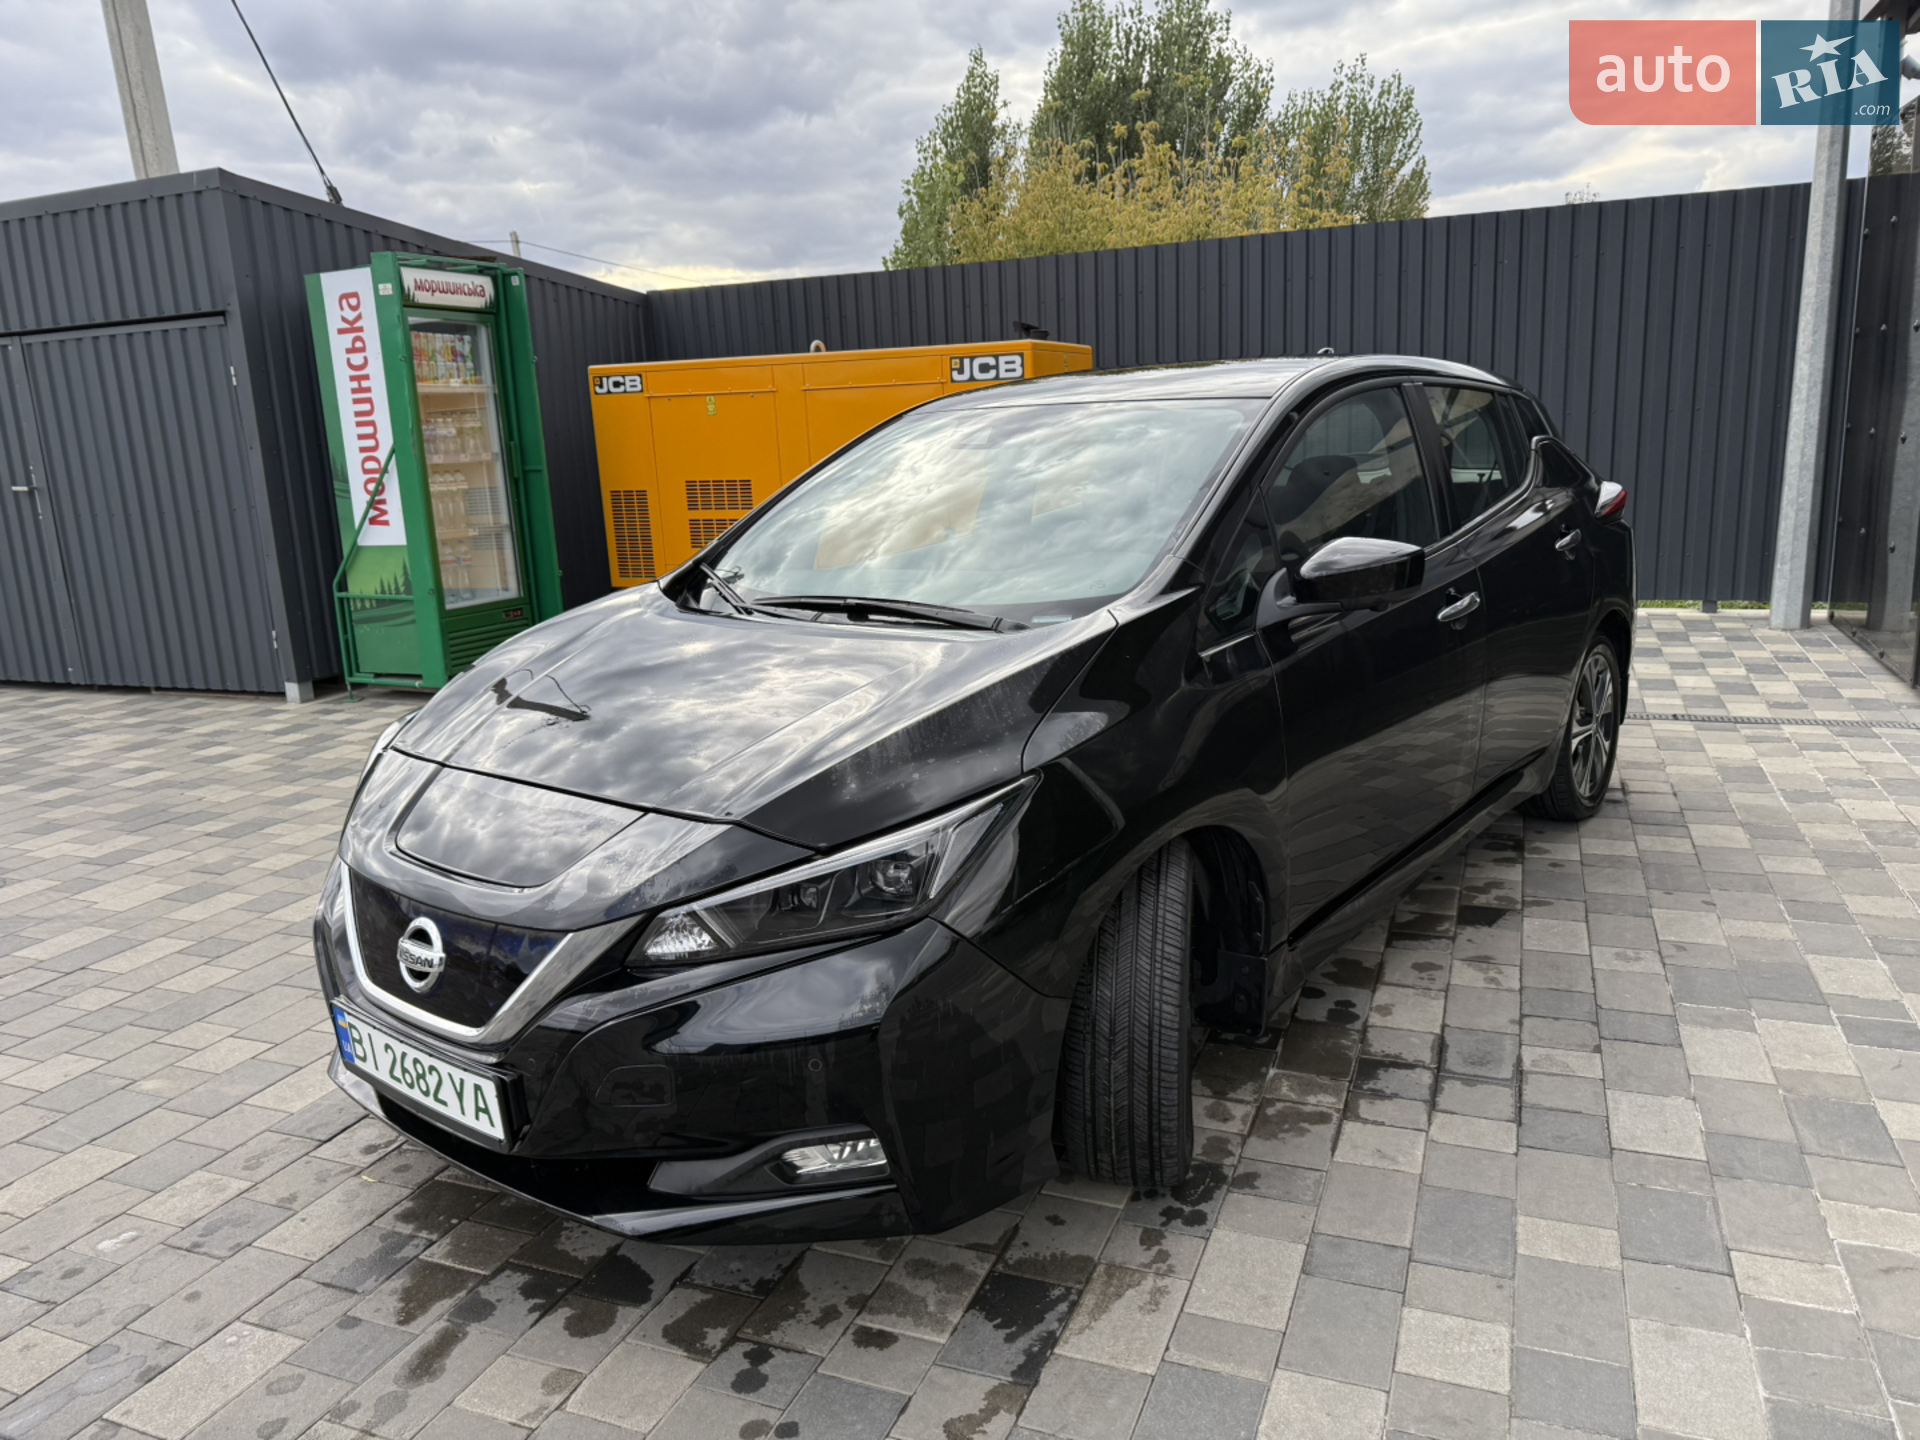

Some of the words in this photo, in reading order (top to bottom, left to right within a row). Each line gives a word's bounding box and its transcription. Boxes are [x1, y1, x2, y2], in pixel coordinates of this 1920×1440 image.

[952, 354, 1023, 381] JCB
[594, 375, 642, 393] JCB
[337, 291, 390, 527] моршинська
